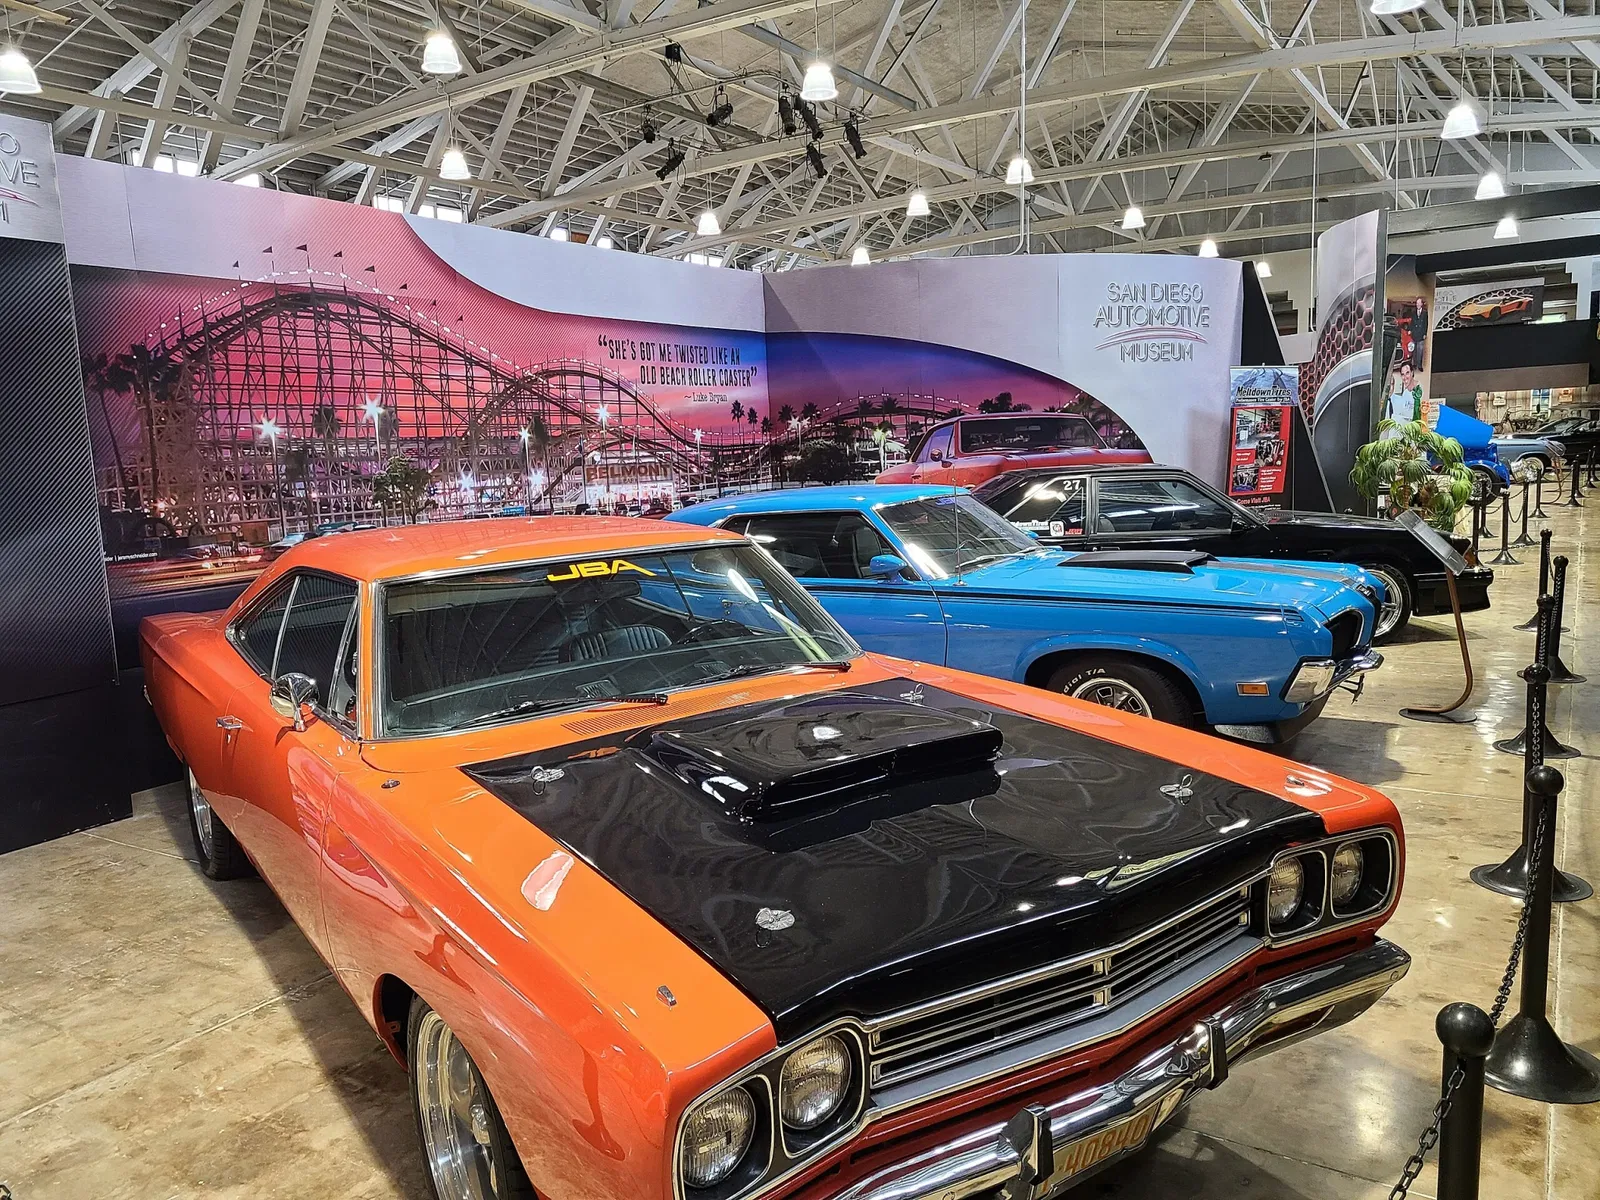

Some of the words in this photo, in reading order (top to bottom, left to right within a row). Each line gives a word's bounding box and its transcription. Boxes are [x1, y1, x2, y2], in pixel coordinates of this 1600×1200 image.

[1107, 282, 1147, 303] SAN
[1150, 282, 1204, 304] DIEGO
[1093, 304, 1210, 328] AUTOMOTIVE
[640, 341, 656, 361] GOT
[660, 343, 672, 363] ME
[674, 344, 708, 365] TWISTED
[711, 346, 728, 365] LIKE
[731, 348, 740, 366] AN
[1120, 342, 1194, 363] MUSEUM
[640, 365, 656, 385] OLD
[660, 367, 687, 386] BEACH
[689, 367, 716, 387] ROLLER
[693, 392, 708, 402] Luke
[709, 392, 728, 404] Bryan
[586, 463, 671, 483] BELMONT
[1063, 480, 1081, 491] 27
[546, 559, 657, 582] JBA
[1085, 668, 1106, 676] T/A
